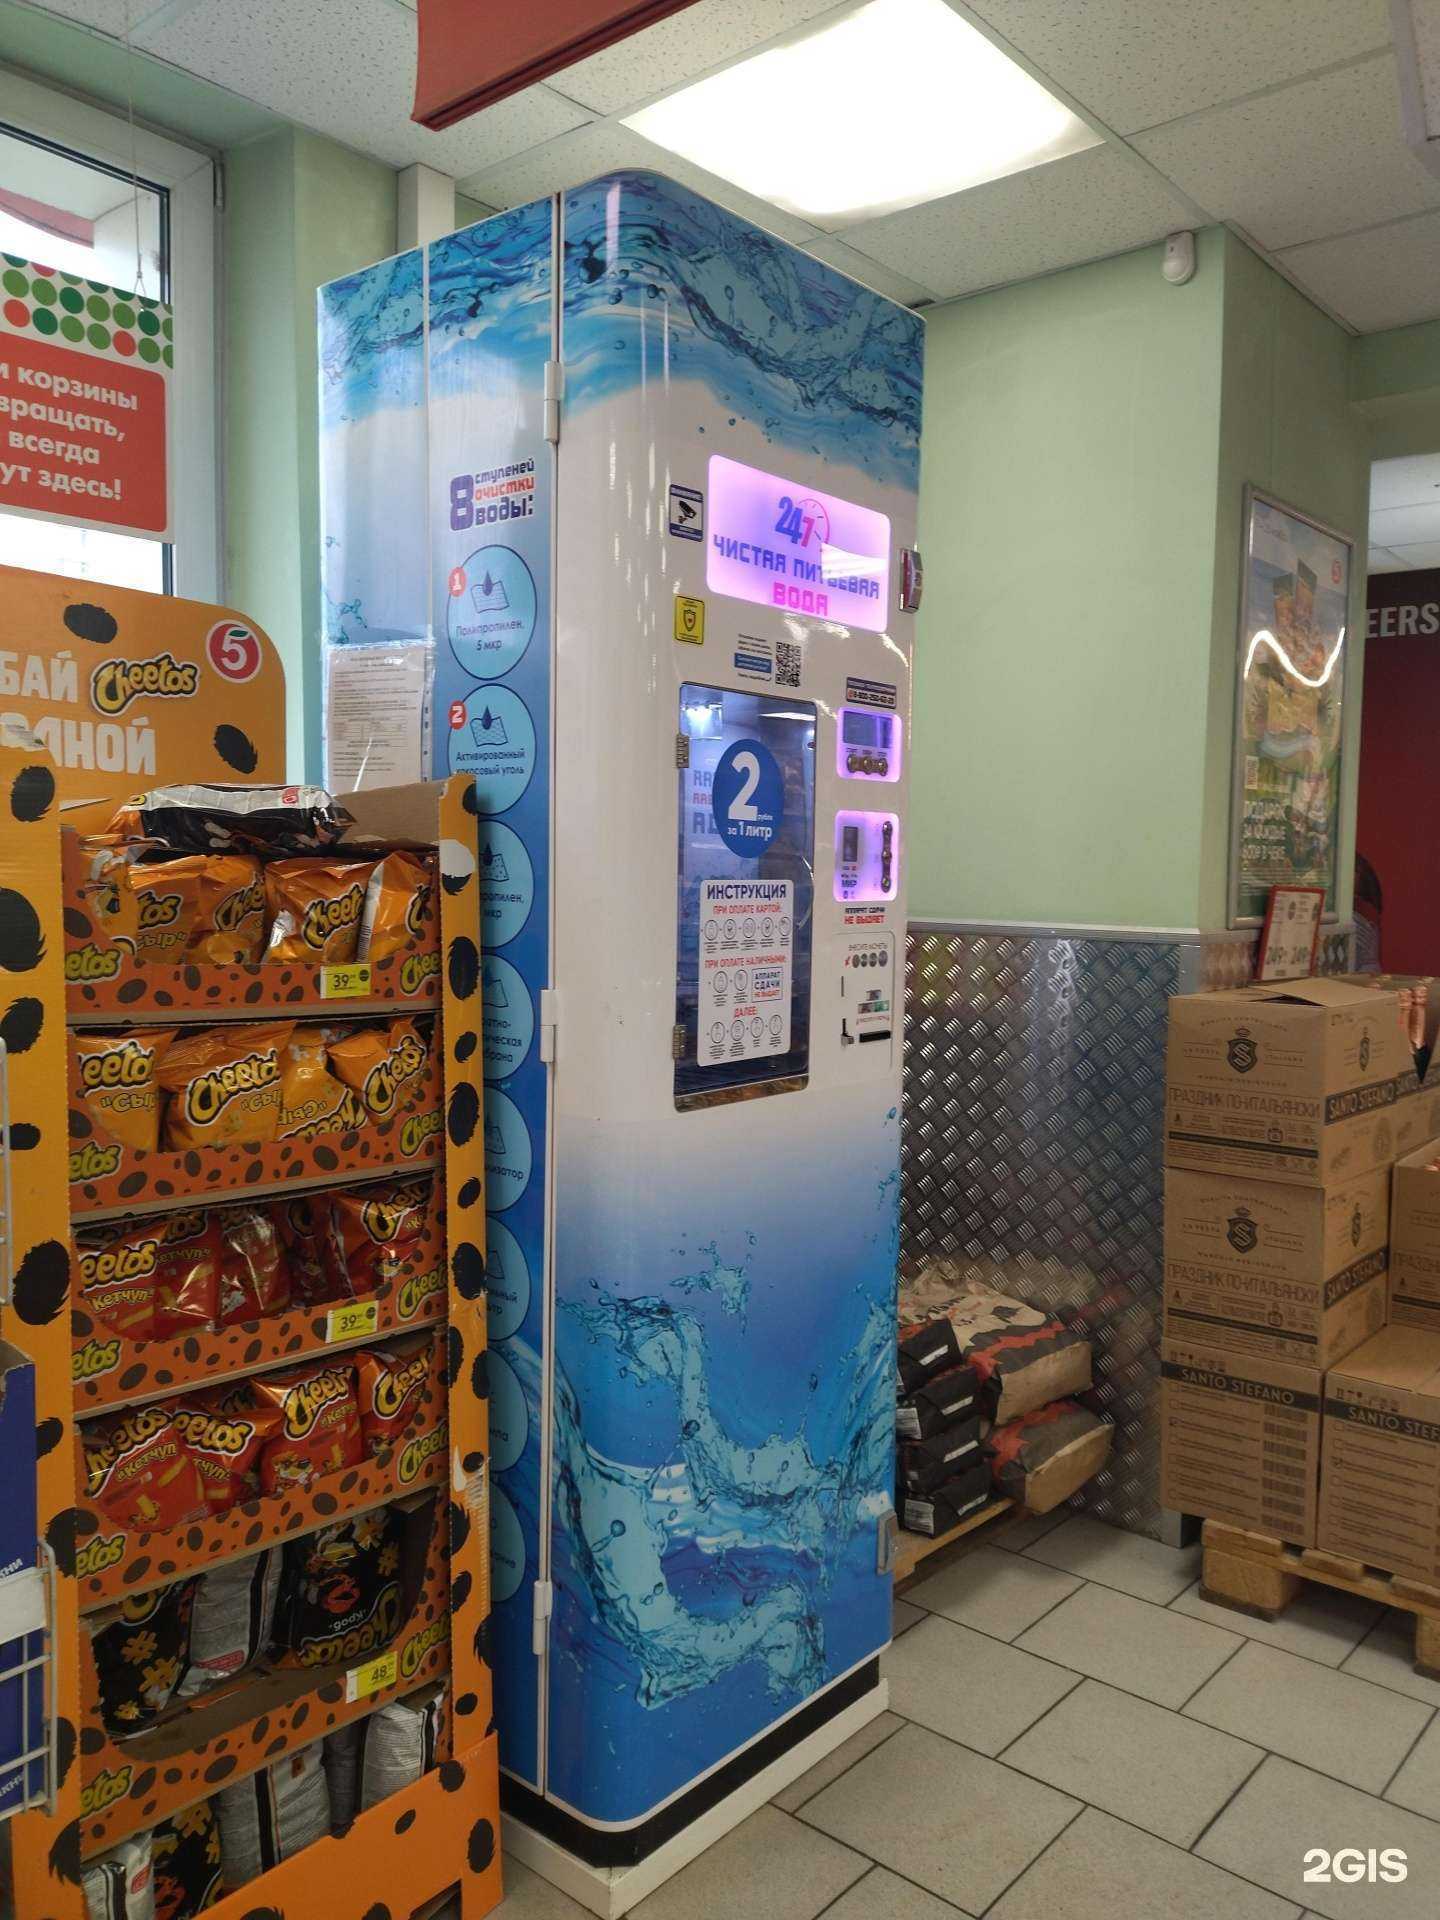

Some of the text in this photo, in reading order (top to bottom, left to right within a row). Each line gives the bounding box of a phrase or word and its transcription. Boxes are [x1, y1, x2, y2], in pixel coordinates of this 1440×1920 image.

[17, 366, 138, 410] корзины
[8, 430, 100, 464] всегда
[37, 470, 122, 500] здесь!
[475, 458, 535, 484] ступеней
[450, 474, 473, 531] 8
[475, 476, 535, 502] очистки
[475, 494, 534, 526] воды:
[713, 534, 787, 574] ЧИСТАЯ
[452, 572, 463, 591] 1
[773, 581, 828, 617] ВОДА
[93, 654, 197, 715] Cheetos
[451, 705, 463, 723] 2
[727, 750, 761, 822] 2
[739, 821, 744, 836] 1
[745, 824, 774, 842] литр
[707, 884, 787, 901] ИНСТРУКЦИЯ
[1181, 1368, 1295, 1405] SANTO STEFANO
[1348, 1406, 1401, 1430] SANTO
